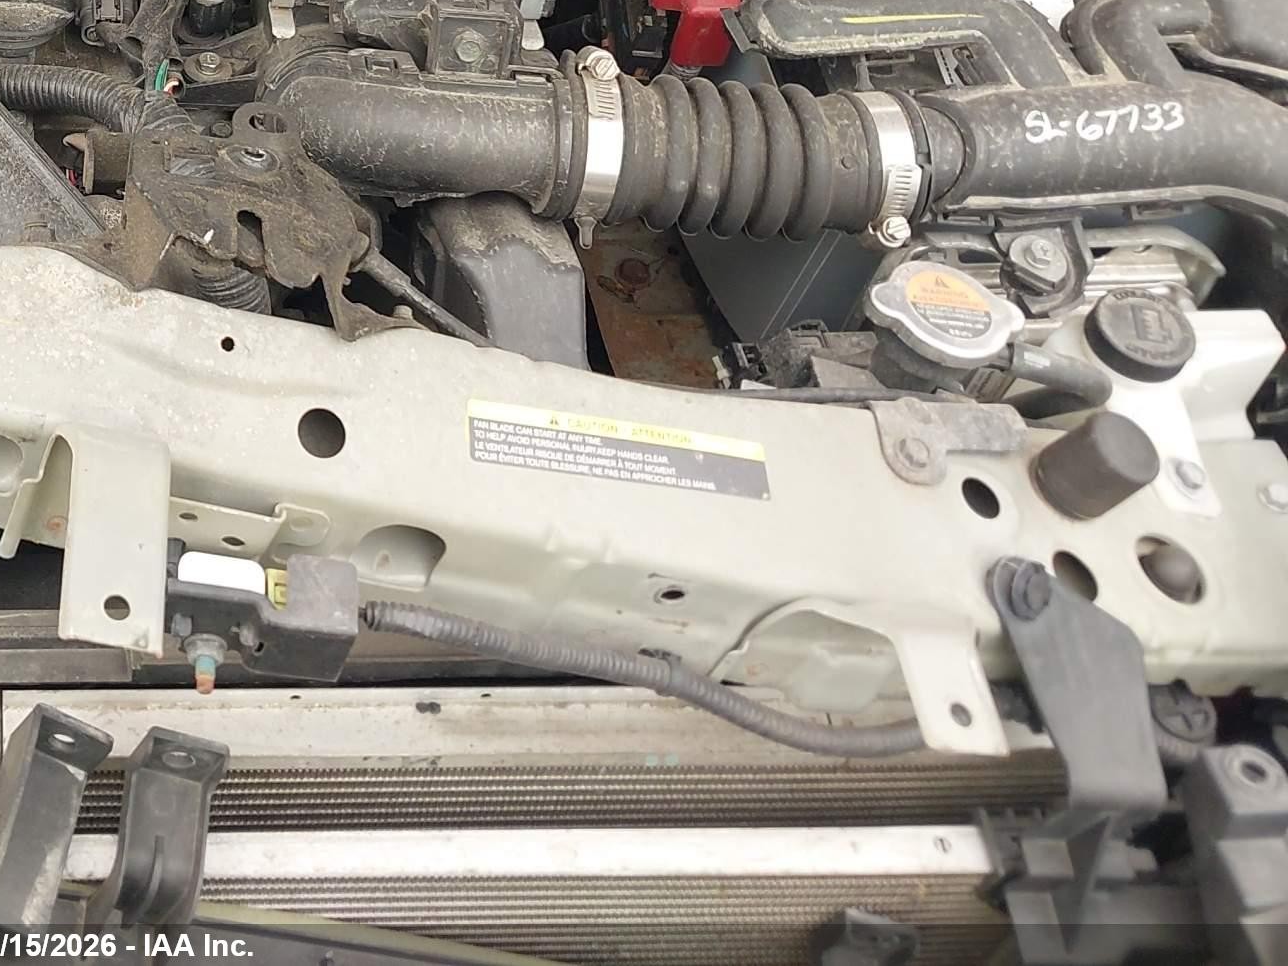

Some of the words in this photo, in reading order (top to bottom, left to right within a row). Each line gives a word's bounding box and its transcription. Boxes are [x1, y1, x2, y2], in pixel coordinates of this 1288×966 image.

[473, 429, 486, 439] TO
[486, 430, 507, 442] HELP
[507, 434, 530, 445] AVOID
[531, 436, 571, 451] PERSONAL
[617, 450, 643, 461] HANDS
[474, 419, 489, 429] FAN
[489, 421, 515, 433] BLADE
[515, 424, 533, 435] CAN
[533, 427, 557, 439] START
[567, 431, 583, 442] ANY
[566, 418, 618, 434] CAUTION
[631, 427, 693, 445] ATTENTION
[474, 440, 485, 450] LE
[624, 461, 643, 472] TOUT
[474, 451, 498, 462] POUR
[498, 452, 524, 466] ÉVITER
[525, 457, 549, 469] TOUTE
[603, 467, 620, 479] PAS
[631, 472, 678, 487] APPROCHER
[677, 478, 691, 488] LES
